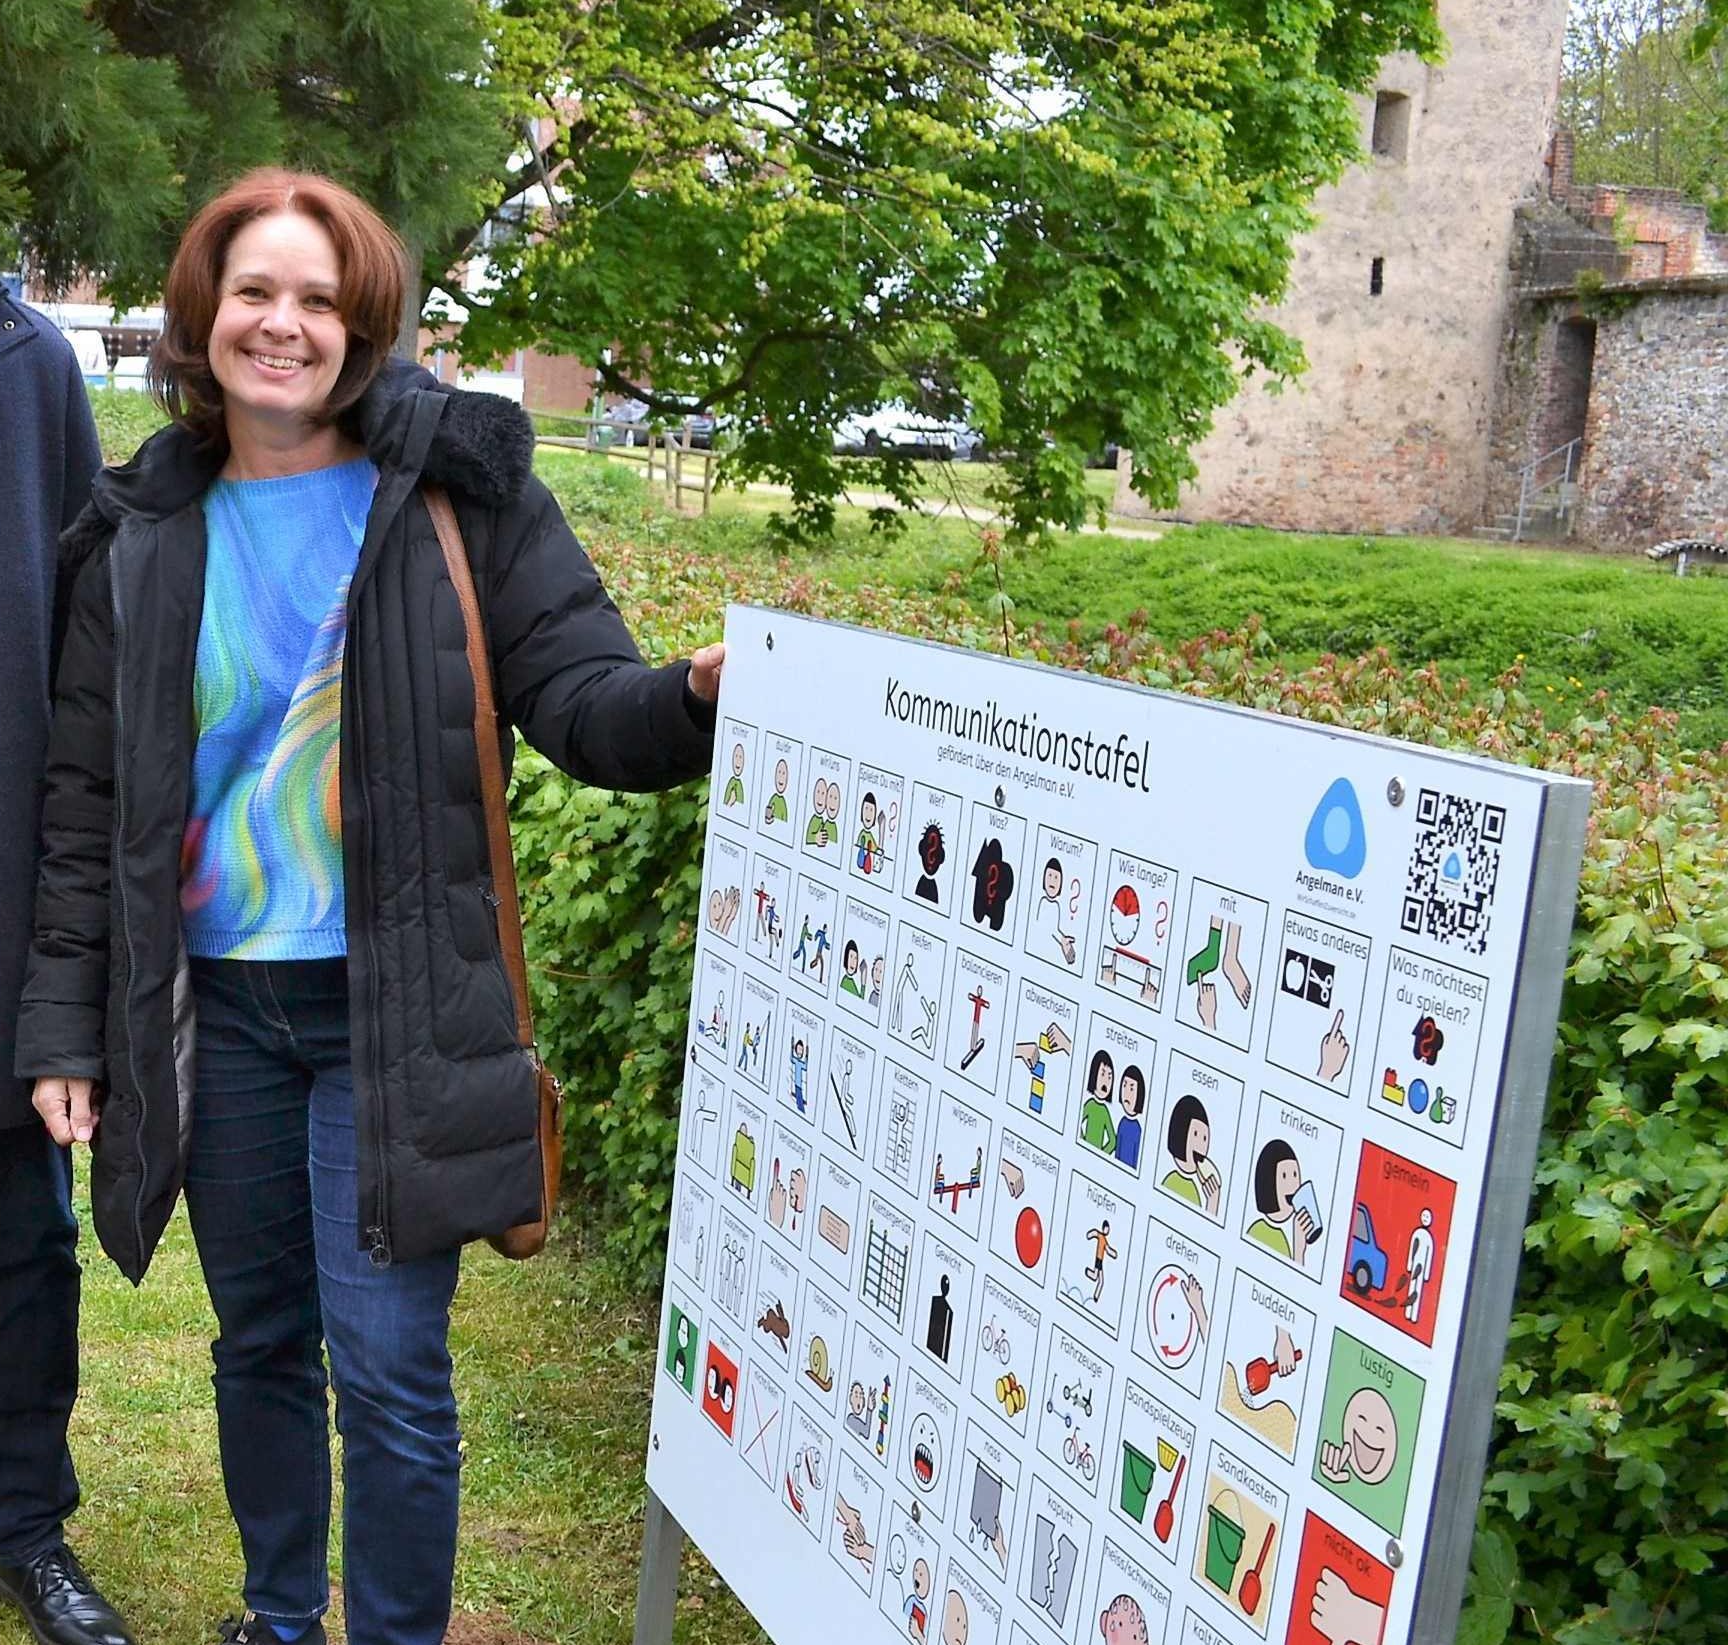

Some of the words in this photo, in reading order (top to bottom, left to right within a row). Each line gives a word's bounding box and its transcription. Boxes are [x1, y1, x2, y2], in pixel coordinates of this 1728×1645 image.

[885, 677, 1149, 792] Kommunikationstafel
[937, 744, 974, 768] gefördert
[974, 753, 994, 774] über
[995, 760, 1012, 779] den
[1012, 765, 1057, 794] Angelman
[1058, 781, 1075, 800] e.V.
[928, 791, 946, 809] Wer?
[988, 812, 1009, 831] Was?
[1050, 833, 1084, 858] Warum?
[1118, 857, 1135, 877] Wie
[1136, 863, 1169, 889] lange?
[1295, 871, 1344, 897] Angelman
[1346, 887, 1364, 905] e.V.
[1219, 895, 1237, 914] mit
[1285, 919, 1319, 943] etwas
[1322, 933, 1368, 961] anderes
[961, 955, 1003, 986] balancieren
[1392, 952, 1420, 979] Was
[1421, 967, 1484, 1003] möchtest
[1025, 987, 1071, 1020] abwechseln
[1396, 984, 1413, 1005] du
[1417, 995, 1471, 1026] spielen?
[1105, 1027, 1139, 1053] streiten
[1191, 1068, 1219, 1091] essen
[952, 1106, 978, 1129] wippen
[1280, 1108, 1319, 1140] trinken
[1003, 1135, 1015, 1151] mit
[1016, 1141, 1030, 1160] Ball
[1032, 1153, 1057, 1176] spielen
[1383, 1160, 1430, 1193] gemein
[1086, 1184, 1117, 1215] hüpfen
[934, 1244, 962, 1274] Gewicht
[1165, 1234, 1199, 1265] drehen
[1251, 1283, 1296, 1324] buddeln
[1059, 1335, 1103, 1379] Fahrzeuge
[1359, 1348, 1395, 1389] lustig
[1127, 1385, 1193, 1449] Sandspielzeug
[983, 1440, 1001, 1463] nass
[1217, 1451, 1278, 1509] Sandkasten
[1047, 1492, 1074, 1528] kaputt
[1323, 1532, 1355, 1565] nicht
[1355, 1557, 1372, 1578] ok
[1104, 1542, 1168, 1608] heiss/schwitzen
